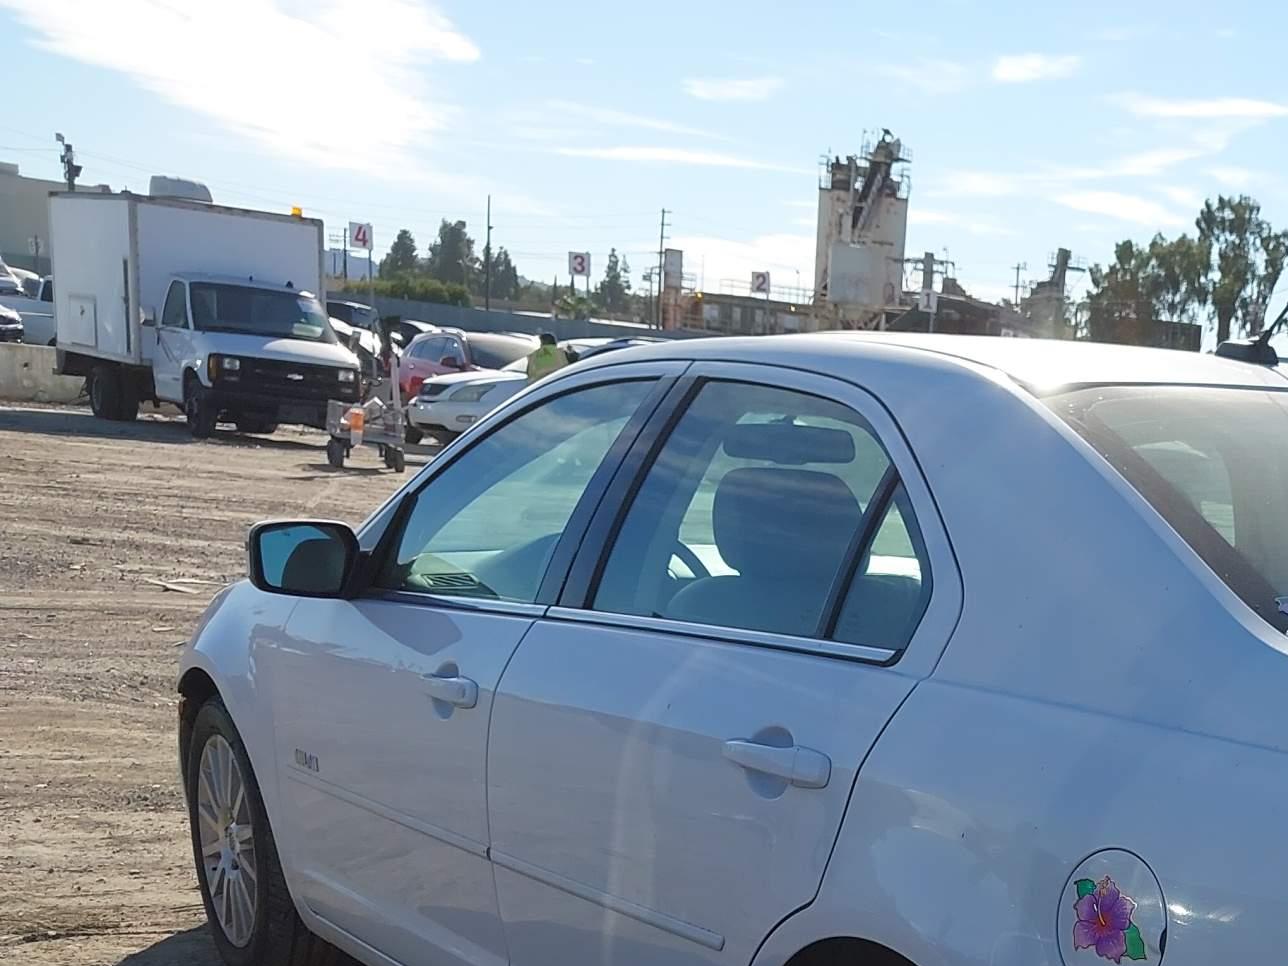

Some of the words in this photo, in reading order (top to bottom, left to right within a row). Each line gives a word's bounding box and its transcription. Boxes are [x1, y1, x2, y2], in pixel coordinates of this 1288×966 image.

[354, 224, 369, 247] 4
[573, 254, 586, 274] 3
[755, 272, 767, 292] 2
[923, 291, 934, 310] 1
